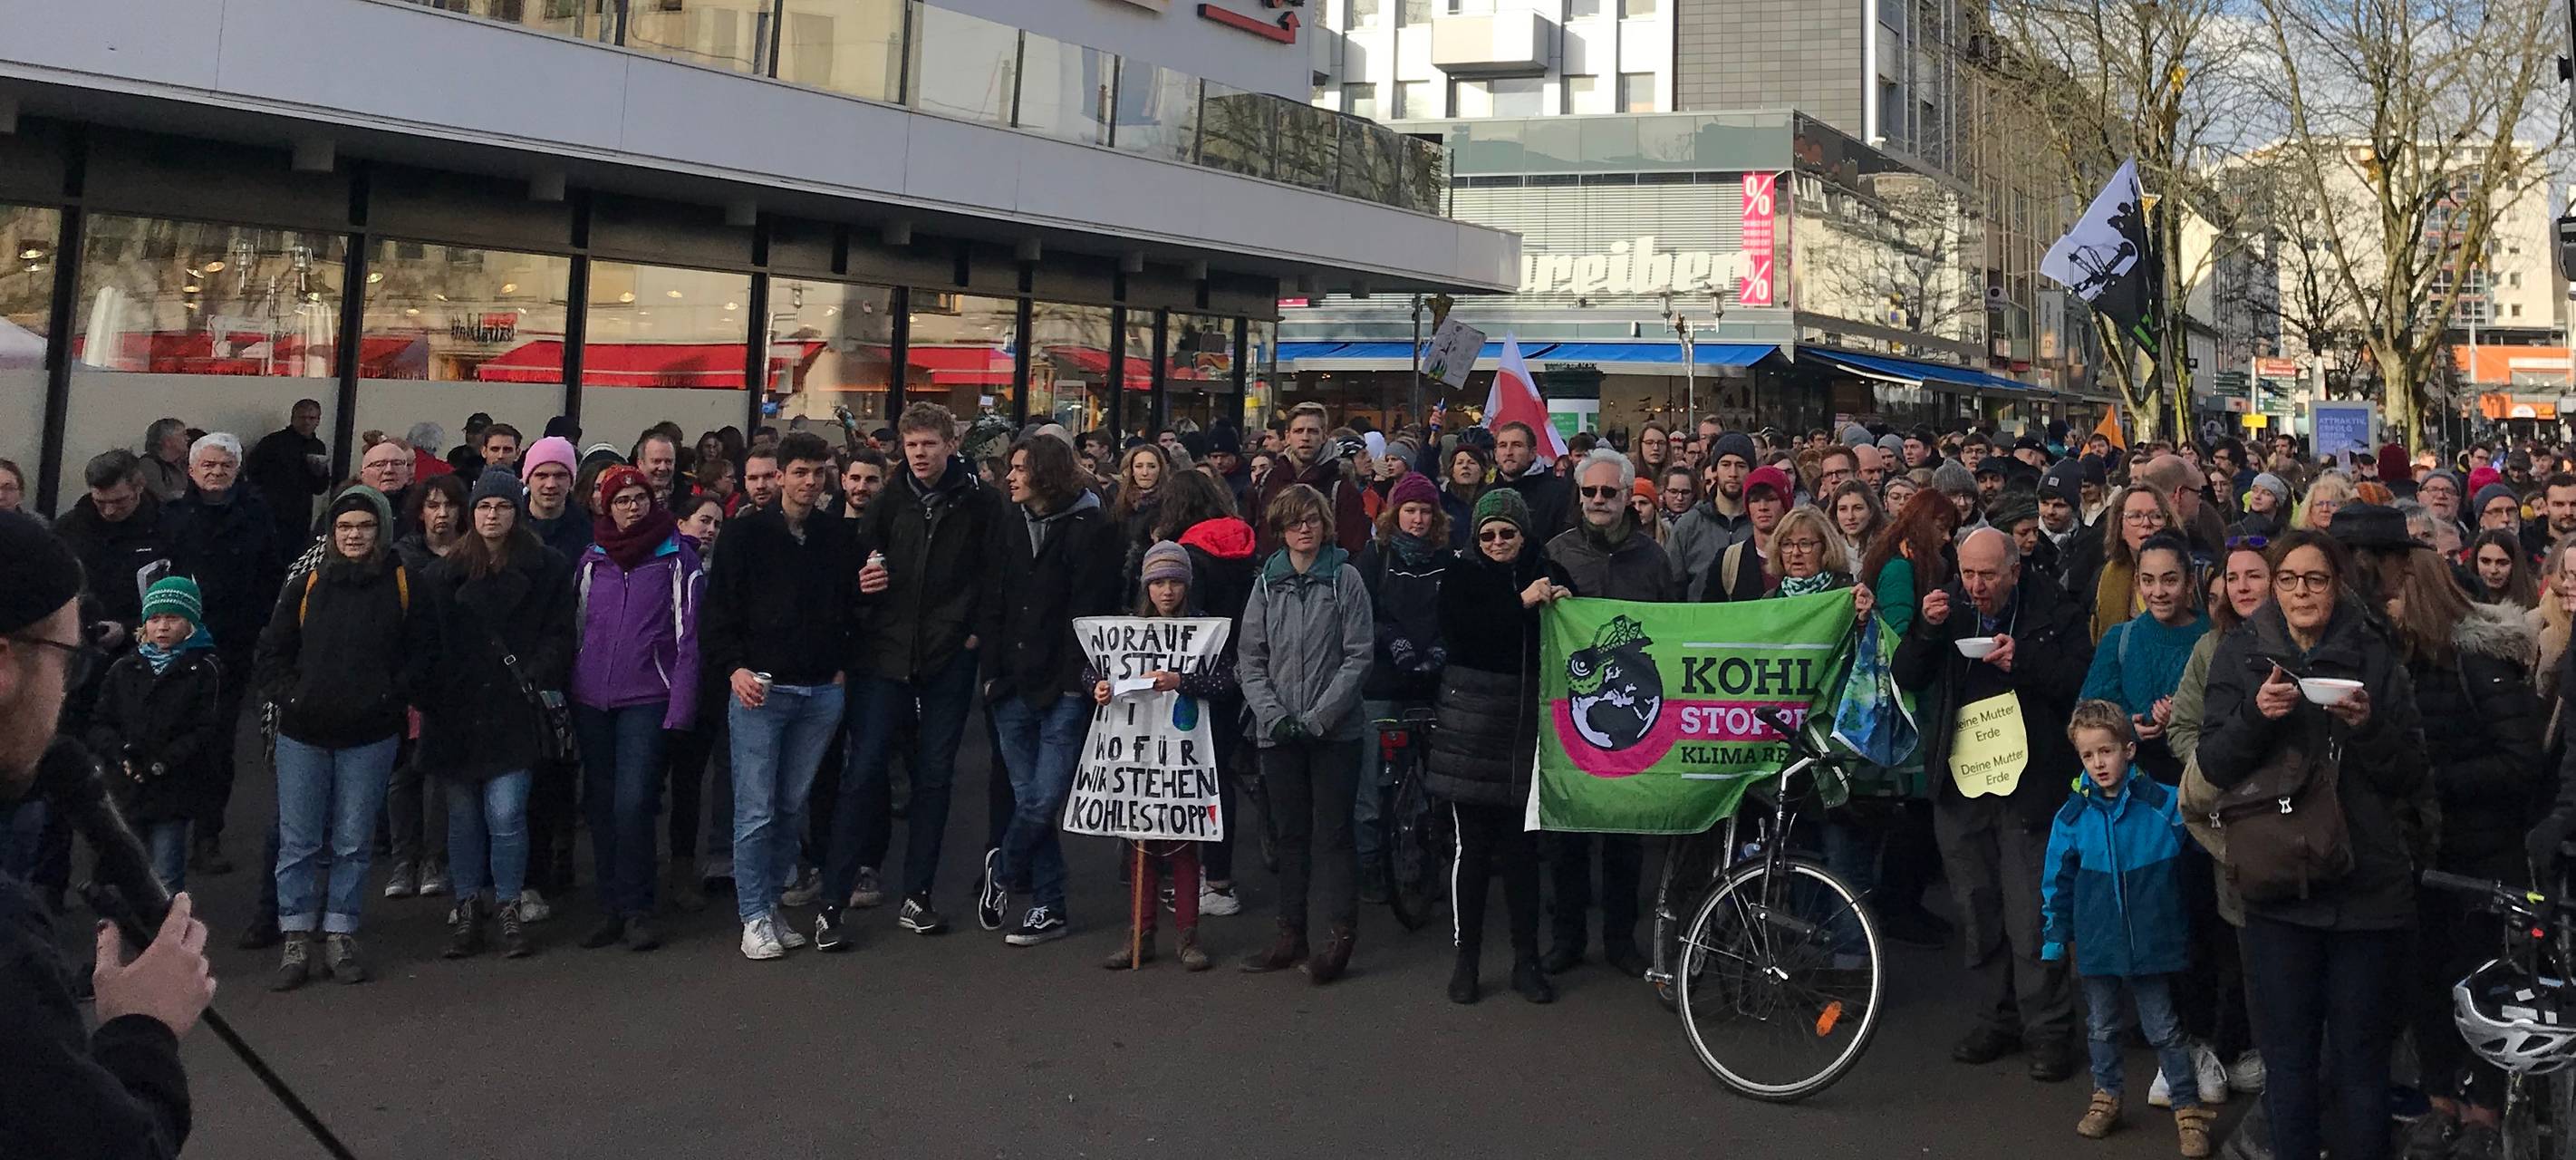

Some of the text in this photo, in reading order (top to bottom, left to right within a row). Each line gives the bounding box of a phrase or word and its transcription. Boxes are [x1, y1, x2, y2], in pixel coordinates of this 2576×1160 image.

[1957, 705, 2014, 730] eine Mutter
[1975, 728, 2001, 742] Erde
[1681, 747, 1757, 765] KLIMA
[1961, 750, 2023, 776] Deine Mutter
[1113, 767, 1219, 799] STEHEN
[1986, 772, 2010, 786] Erde
[1068, 796, 1218, 836] KOHLESTOPP!
